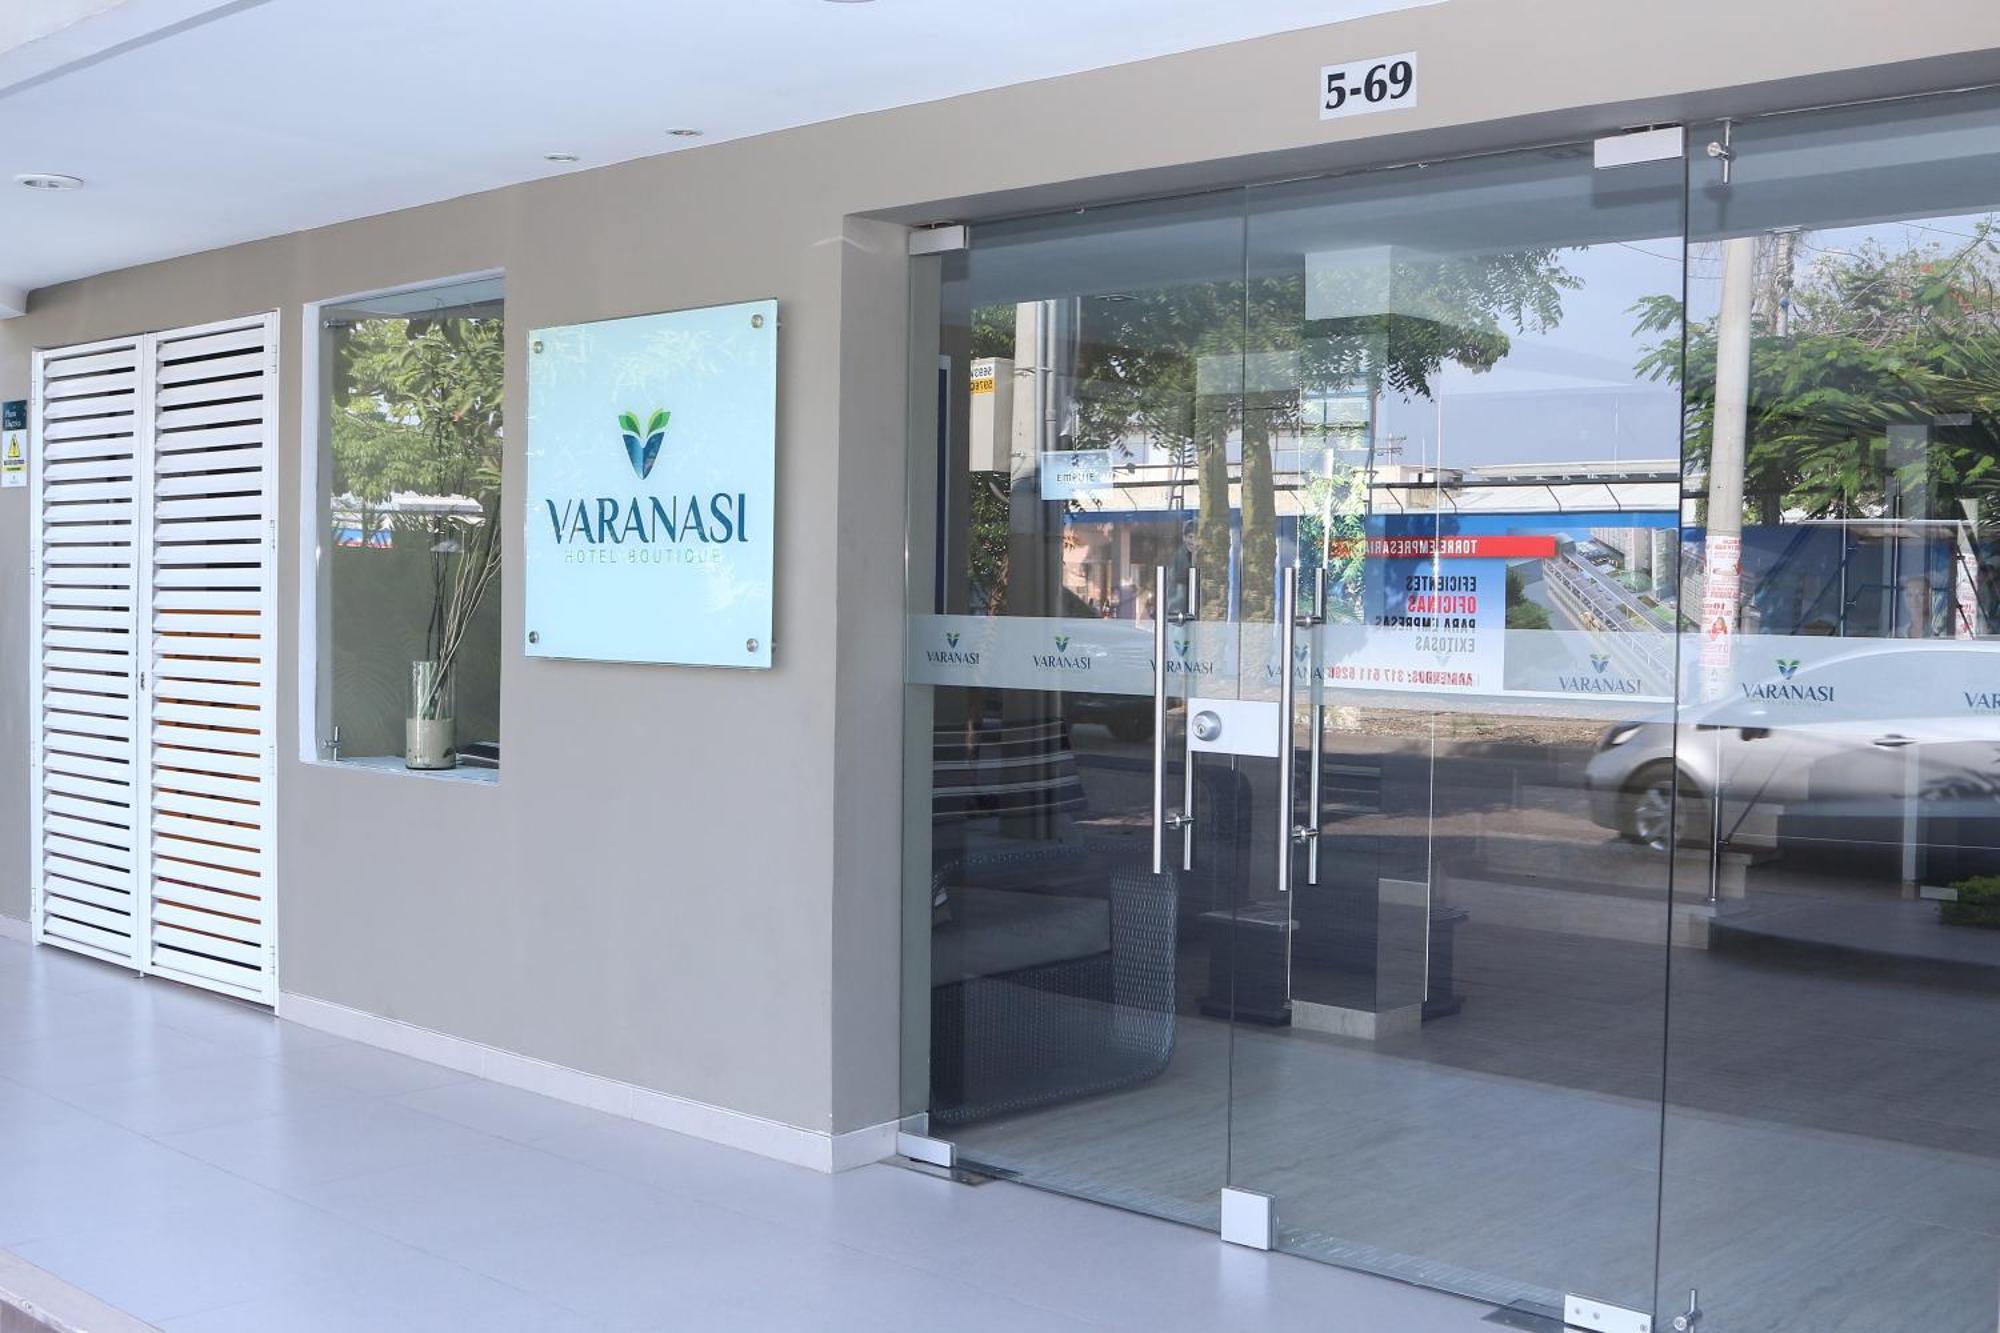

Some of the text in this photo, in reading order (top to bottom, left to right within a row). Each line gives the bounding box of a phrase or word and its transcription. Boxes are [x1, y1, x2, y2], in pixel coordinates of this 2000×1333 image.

[1324, 61, 1413, 110] 5-69
[545, 493, 749, 545] VARANASI
[564, 547, 721, 565] HOTEL BOUTIQUE
[927, 651, 980, 665] VARANASI
[1033, 655, 1091, 670] VARANASI
[1149, 659, 1214, 675] VRANASI
[1558, 675, 1642, 695] VARANASI
[1742, 682, 1835, 702] VARANASI
